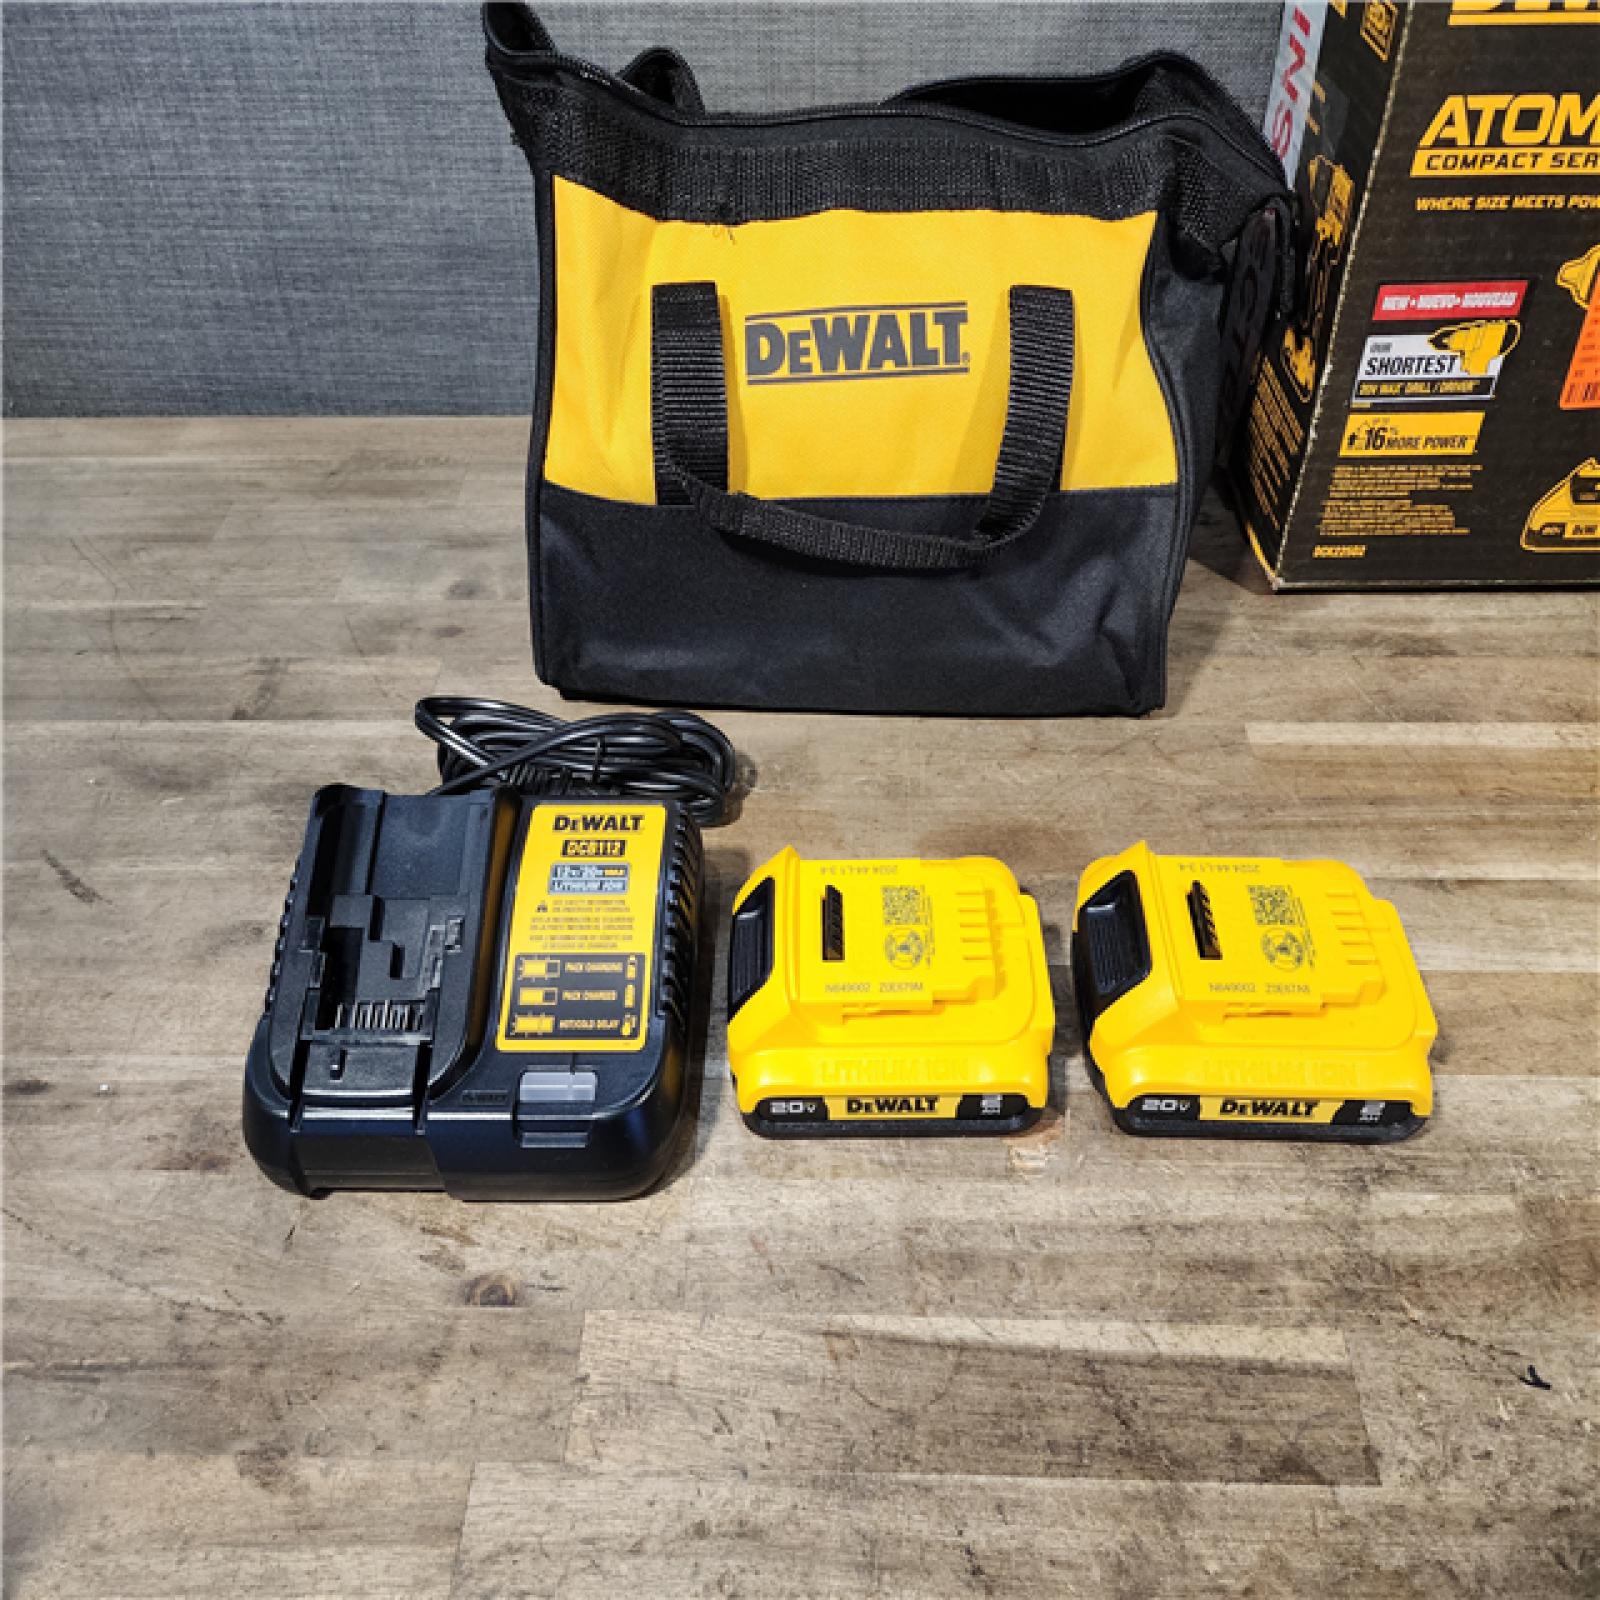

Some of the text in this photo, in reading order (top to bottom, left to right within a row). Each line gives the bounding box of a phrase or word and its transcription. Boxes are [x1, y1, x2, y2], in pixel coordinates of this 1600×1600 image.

[1426, 152, 1543, 171] COMPACT
[1415, 197, 1473, 211] WHERE
[1512, 195, 1566, 209] MEETS
[1365, 355, 1456, 376] SHORTEST
[1386, 435, 1421, 449] MORE
